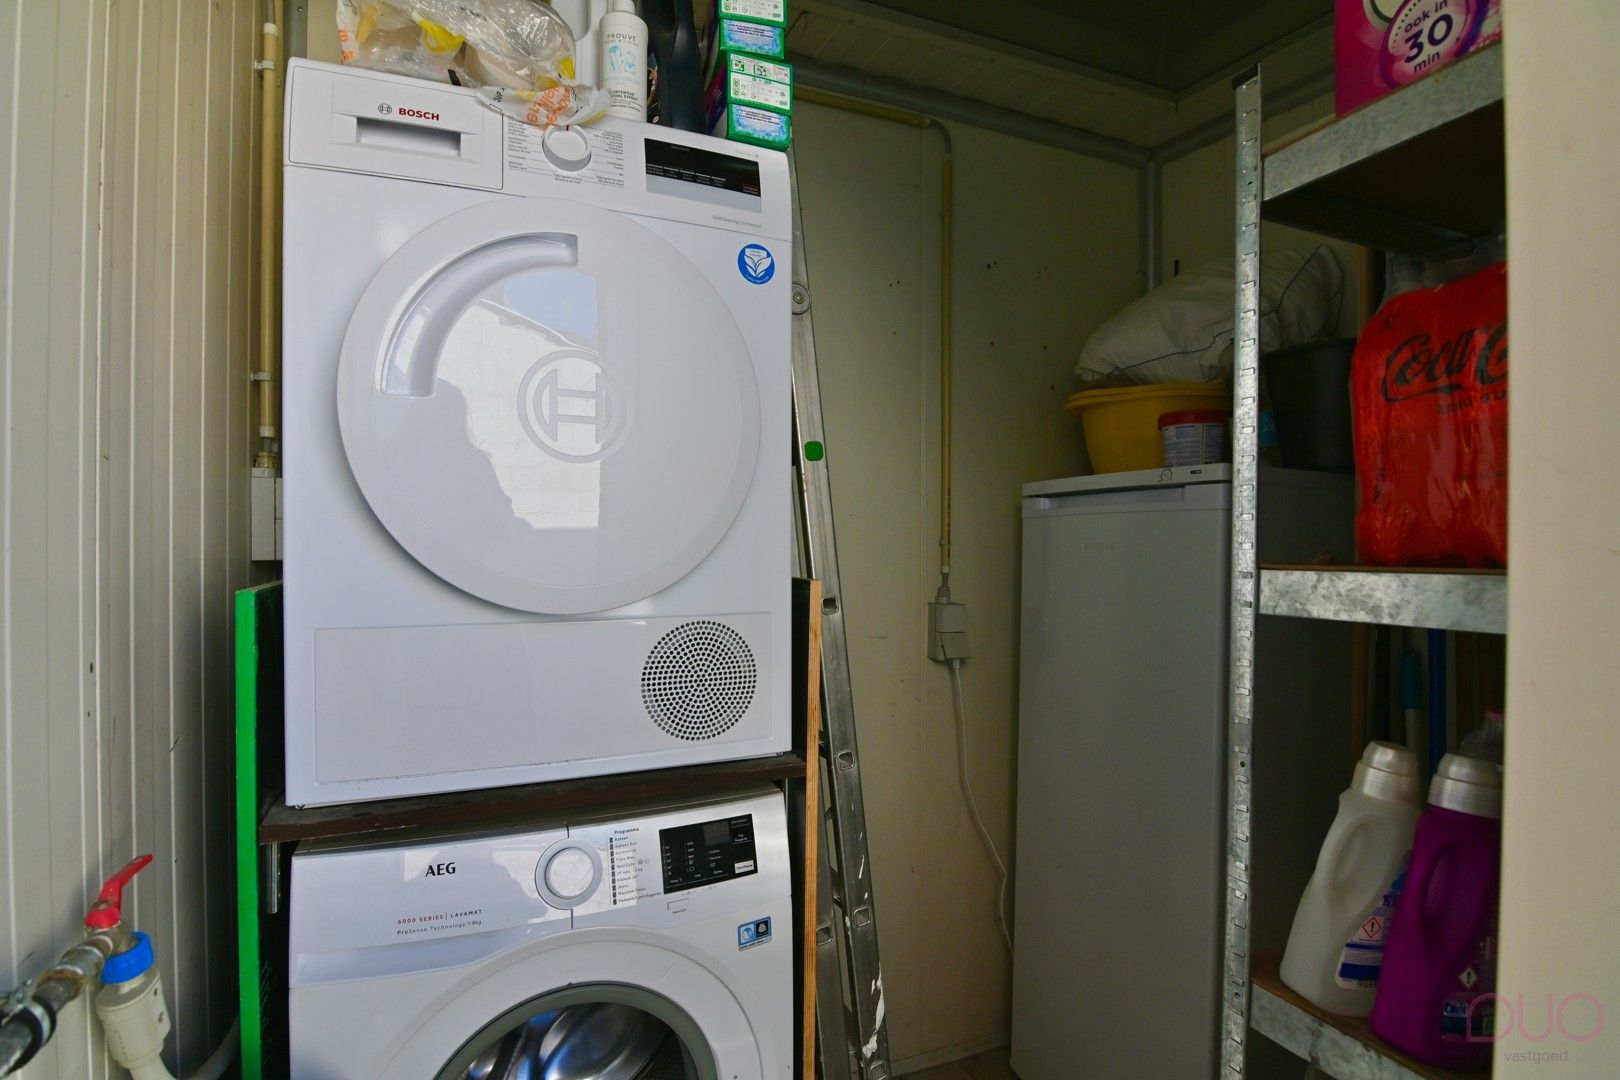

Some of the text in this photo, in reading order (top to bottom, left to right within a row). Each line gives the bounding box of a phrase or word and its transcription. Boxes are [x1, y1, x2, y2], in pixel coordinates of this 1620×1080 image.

[1404, 0, 1449, 33] ook in
[1404, 13, 1454, 64] 30
[1413, 51, 1441, 73] min
[398, 107, 440, 121] BOSCH
[425, 861, 456, 877] AEG
[397, 909, 483, 925] 6000 SERIES LAVAMAT
[396, 926, 428, 935] ProSense
[430, 922, 466, 933] Technology
